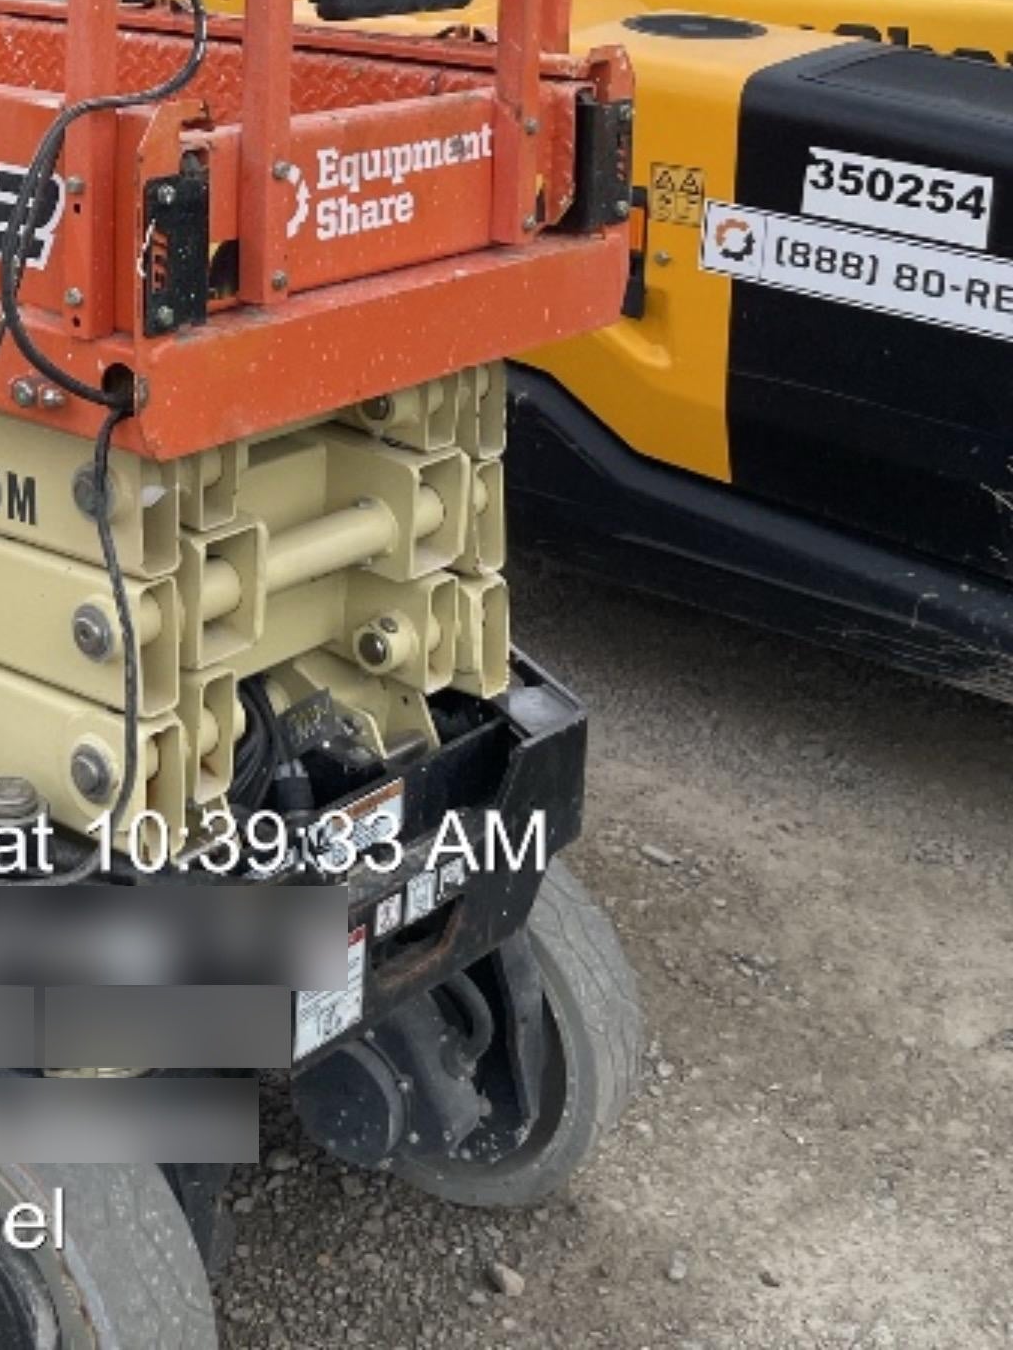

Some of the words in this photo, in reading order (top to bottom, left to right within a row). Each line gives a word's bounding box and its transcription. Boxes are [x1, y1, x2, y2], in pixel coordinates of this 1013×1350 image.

[316, 123, 493, 192] Equipment
[316, 191, 415, 241] Share
[808, 158, 987, 220] 350254
[776, 236, 879, 285] (888)
